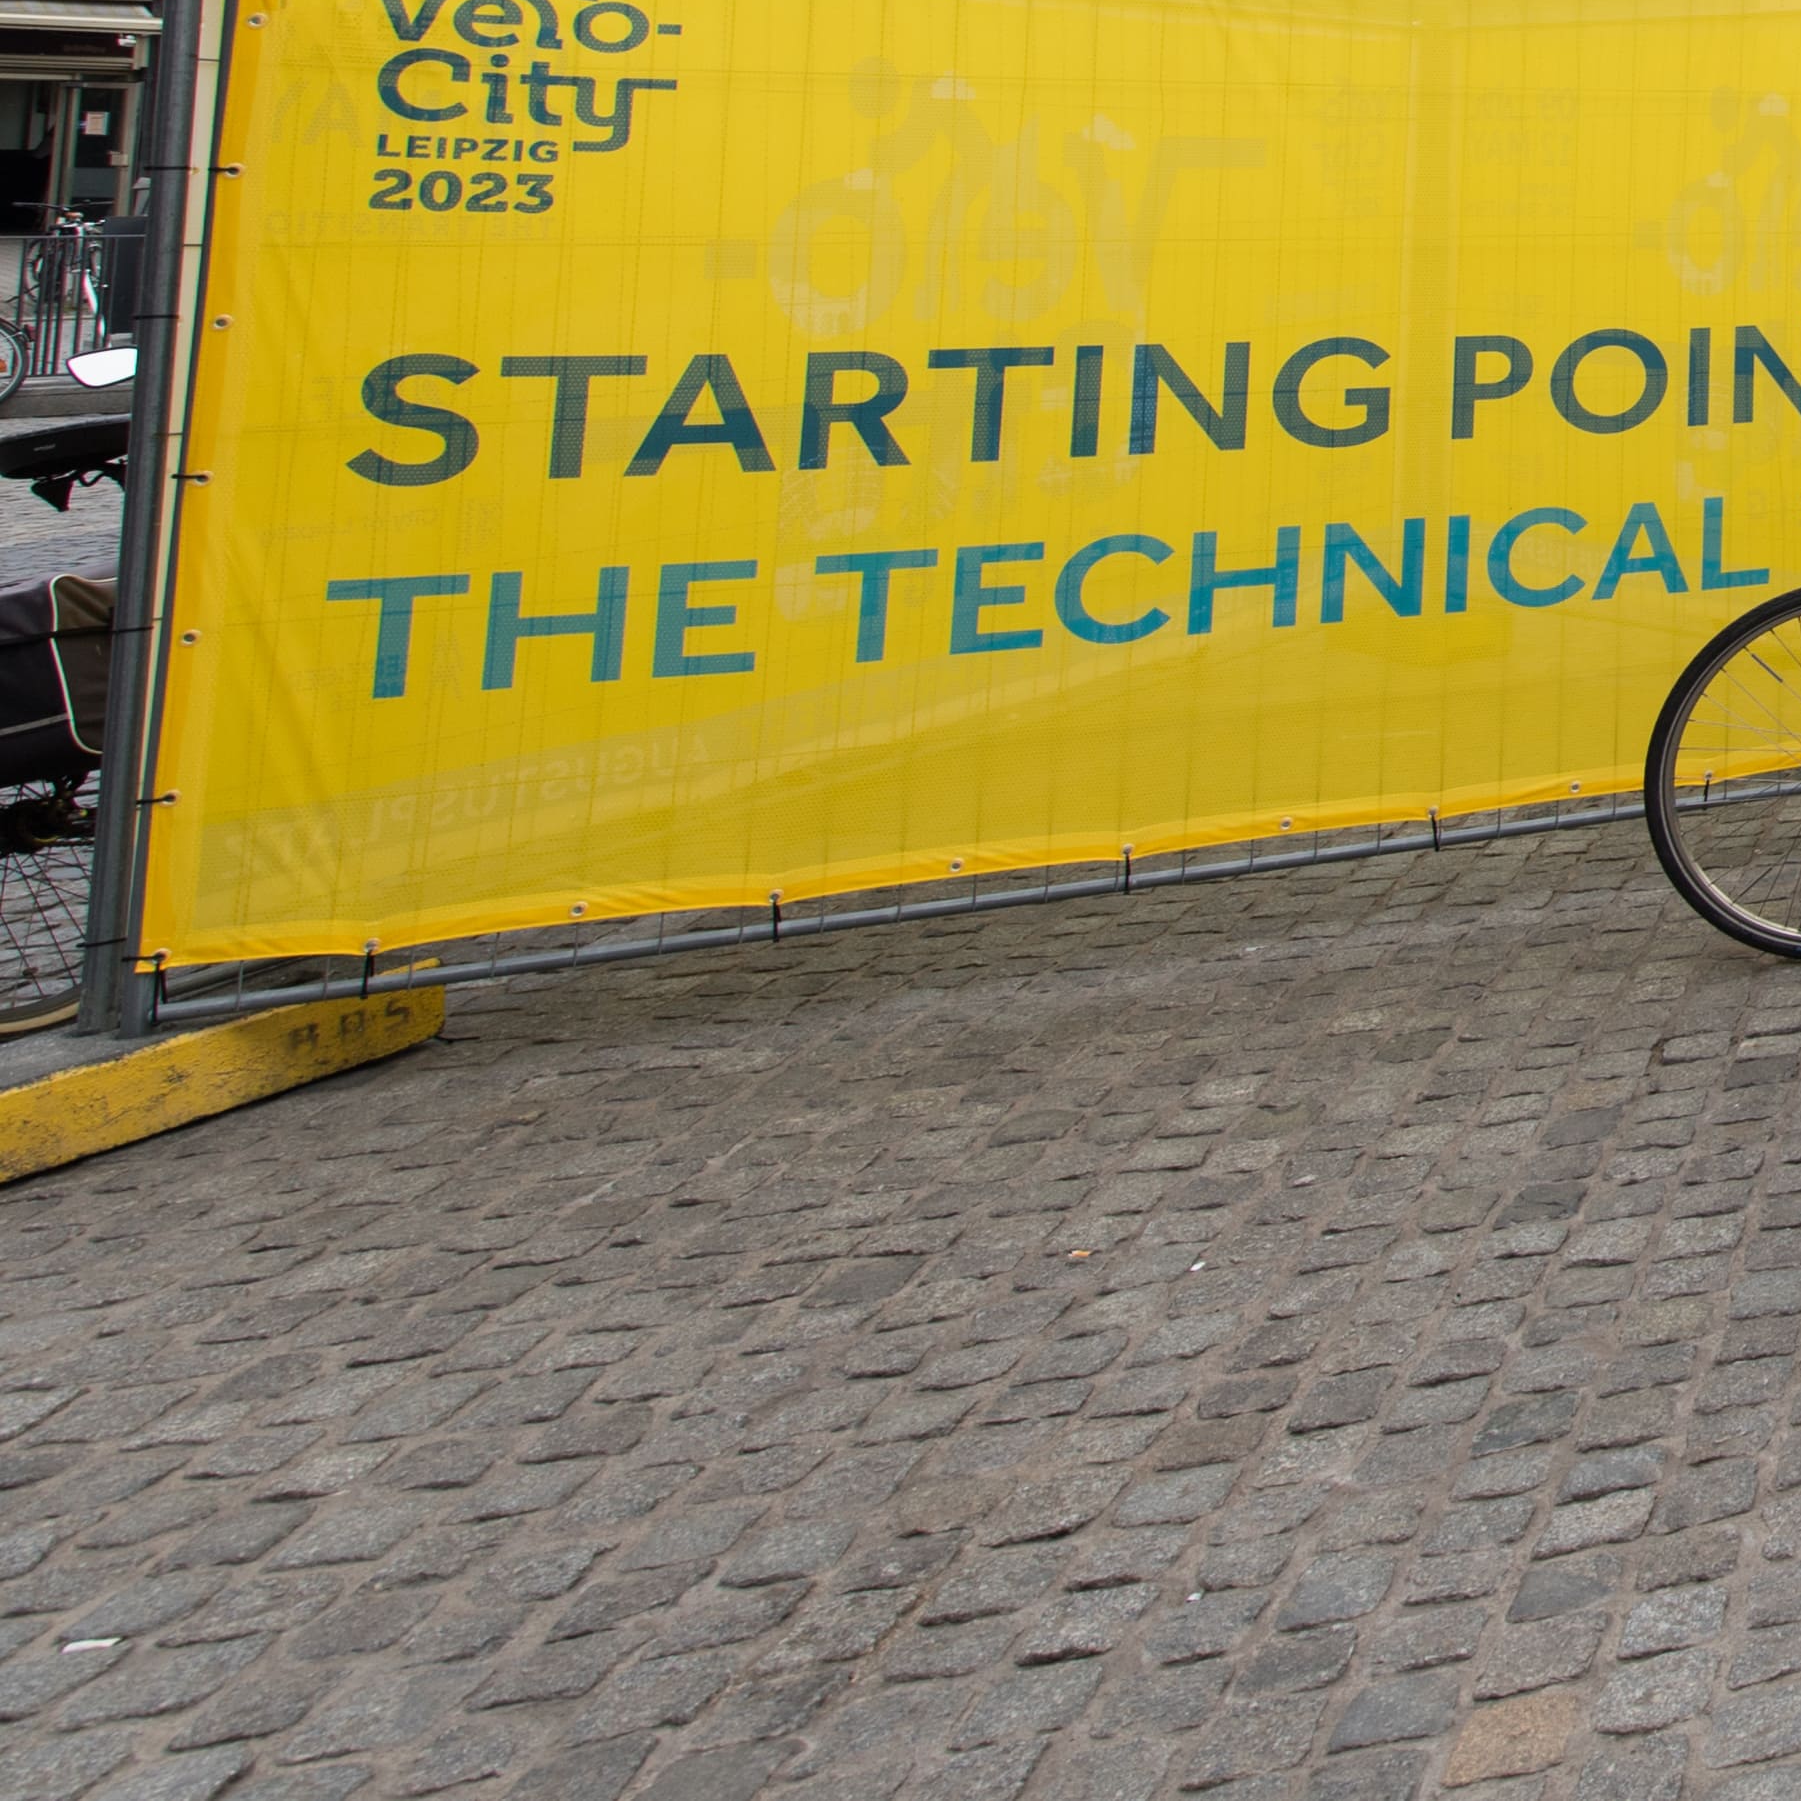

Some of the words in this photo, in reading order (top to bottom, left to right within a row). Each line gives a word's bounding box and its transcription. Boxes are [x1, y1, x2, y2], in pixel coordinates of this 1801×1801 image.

[376, 134, 559, 163] LEIPZIG
[377, 49, 678, 152] City
[369, 170, 554, 213] 2023
[346, 338, 1390, 487] STARTING
[326, 561, 758, 699] THE
[815, 498, 1770, 663] TECHNICAL
